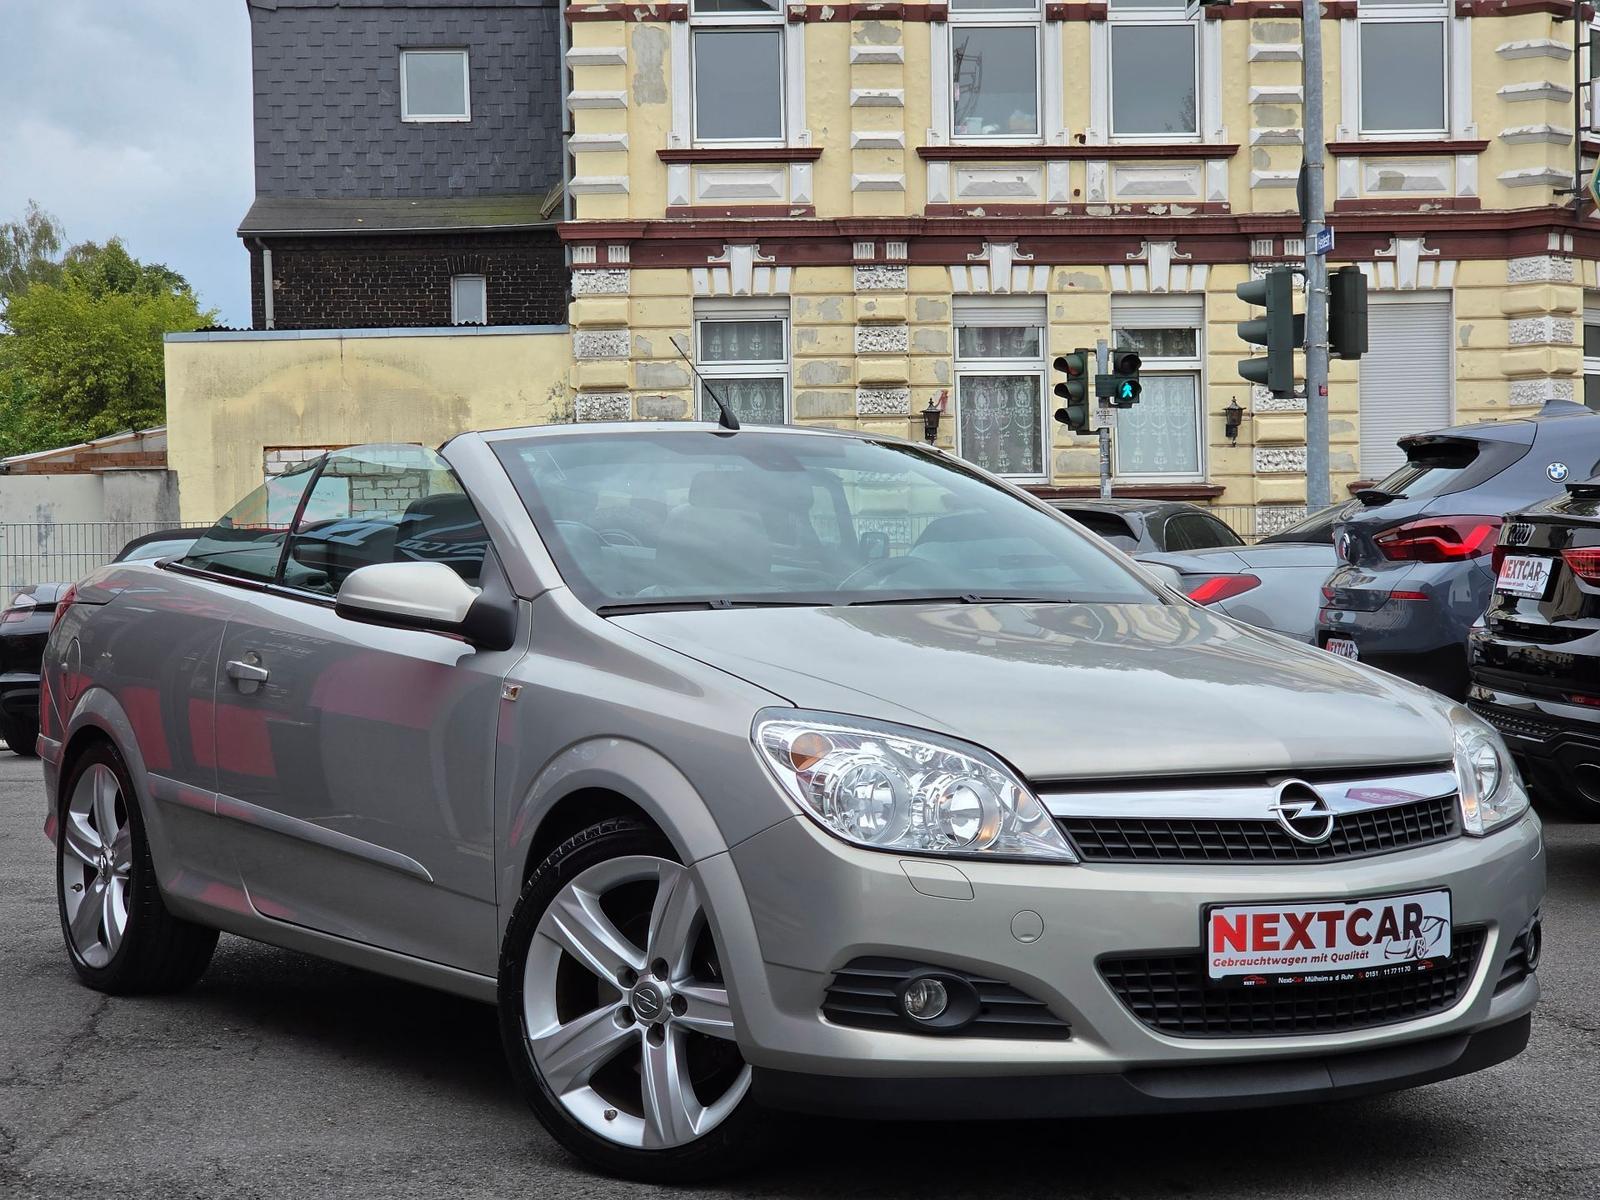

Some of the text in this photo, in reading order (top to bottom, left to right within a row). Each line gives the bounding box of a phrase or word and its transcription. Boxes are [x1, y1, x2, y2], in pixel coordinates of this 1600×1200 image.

[1500, 559, 1543, 582] NEXTCAR
[1212, 902, 1424, 954] NEXTCAR
[1212, 950, 1370, 968] Gebrauchtwagen mit Qualität
[1304, 974, 1329, 983] Mülheim
[1365, 969, 1379, 978] 0151
